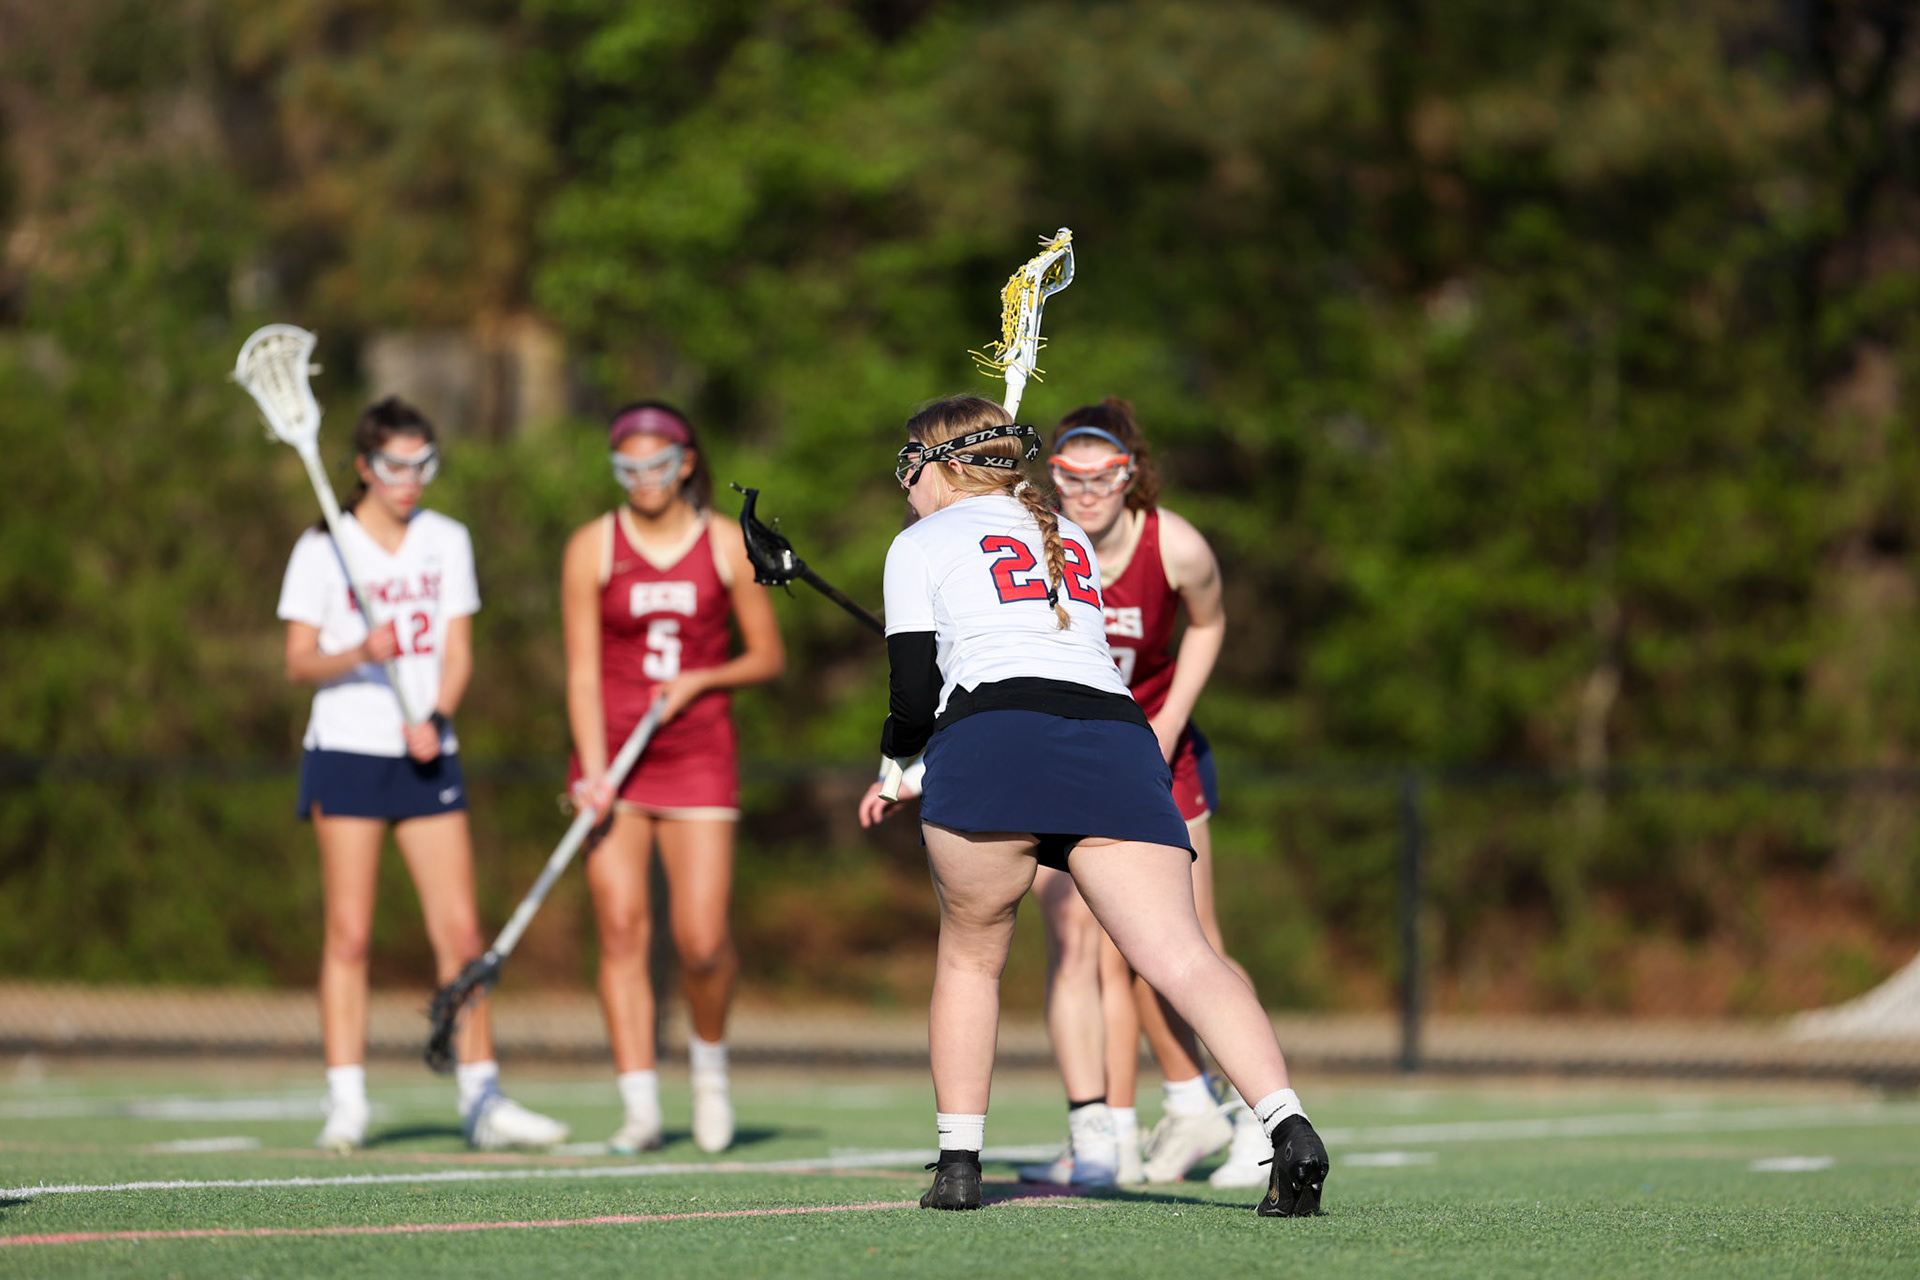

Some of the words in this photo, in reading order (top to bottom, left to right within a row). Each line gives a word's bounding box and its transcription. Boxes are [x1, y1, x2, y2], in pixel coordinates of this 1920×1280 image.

[924, 441, 955, 460] STX
[965, 428, 999, 445] STX
[979, 535, 1101, 611] 22
[391, 611, 434, 657] 12
[1102, 606, 1144, 639] CS
[642, 619, 682, 681] 5
